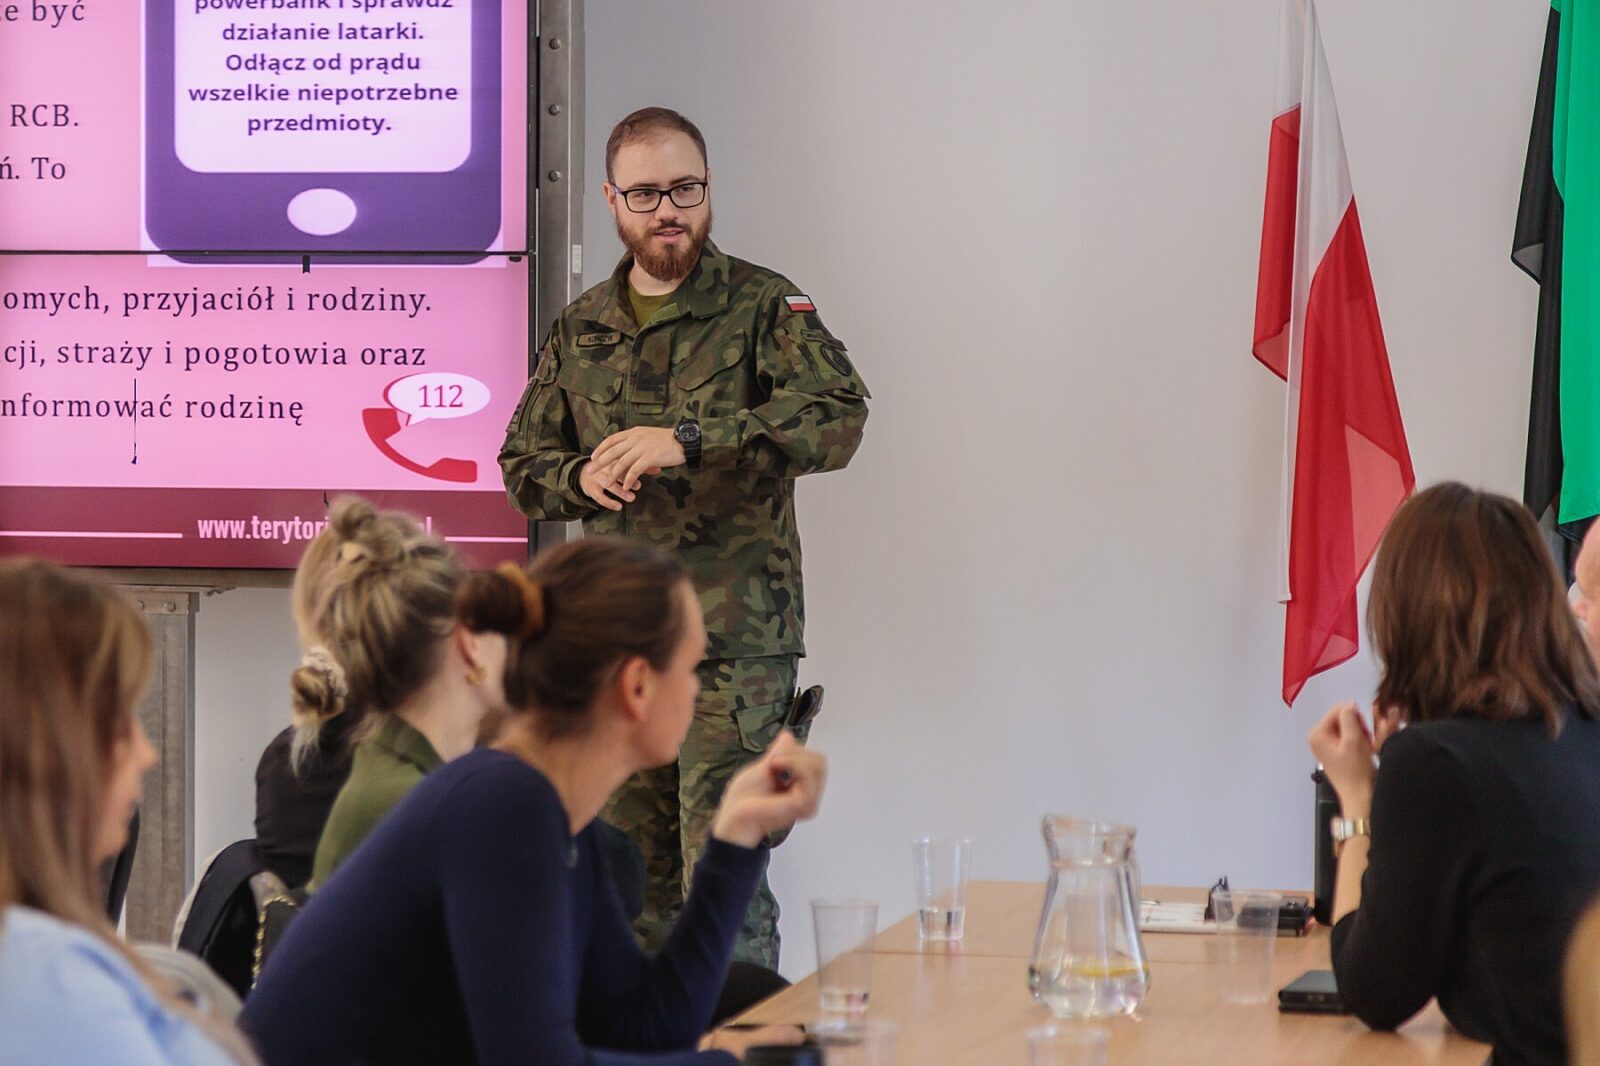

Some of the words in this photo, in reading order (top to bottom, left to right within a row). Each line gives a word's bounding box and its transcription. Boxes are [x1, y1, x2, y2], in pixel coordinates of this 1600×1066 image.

[0, 4, 19, 22] e
[32, 0, 85, 29] być
[222, 22, 331, 41] działanie
[338, 21, 424, 40] latarki.
[225, 53, 307, 76] Odłącz
[312, 53, 342, 71] od
[350, 52, 421, 76] prądu
[188, 83, 290, 102] wszelkie
[298, 82, 459, 106] niepotrzebne
[10, 103, 79, 127] RCB.
[247, 113, 392, 137] przedmioty.
[30, 156, 66, 180] To
[2, 284, 109, 317] omych,
[122, 285, 275, 318] przyjaciół
[286, 287, 296, 311] i
[306, 285, 431, 319] rodziny.
[4, 340, 45, 370] cji,
[57, 340, 153, 372] straży
[165, 341, 173, 365] i
[184, 341, 348, 372] pogotowia
[360, 347, 426, 366] oraz
[418, 384, 464, 408] 112
[0, 392, 172, 418] nformować
[185, 393, 304, 427] rodzinę
